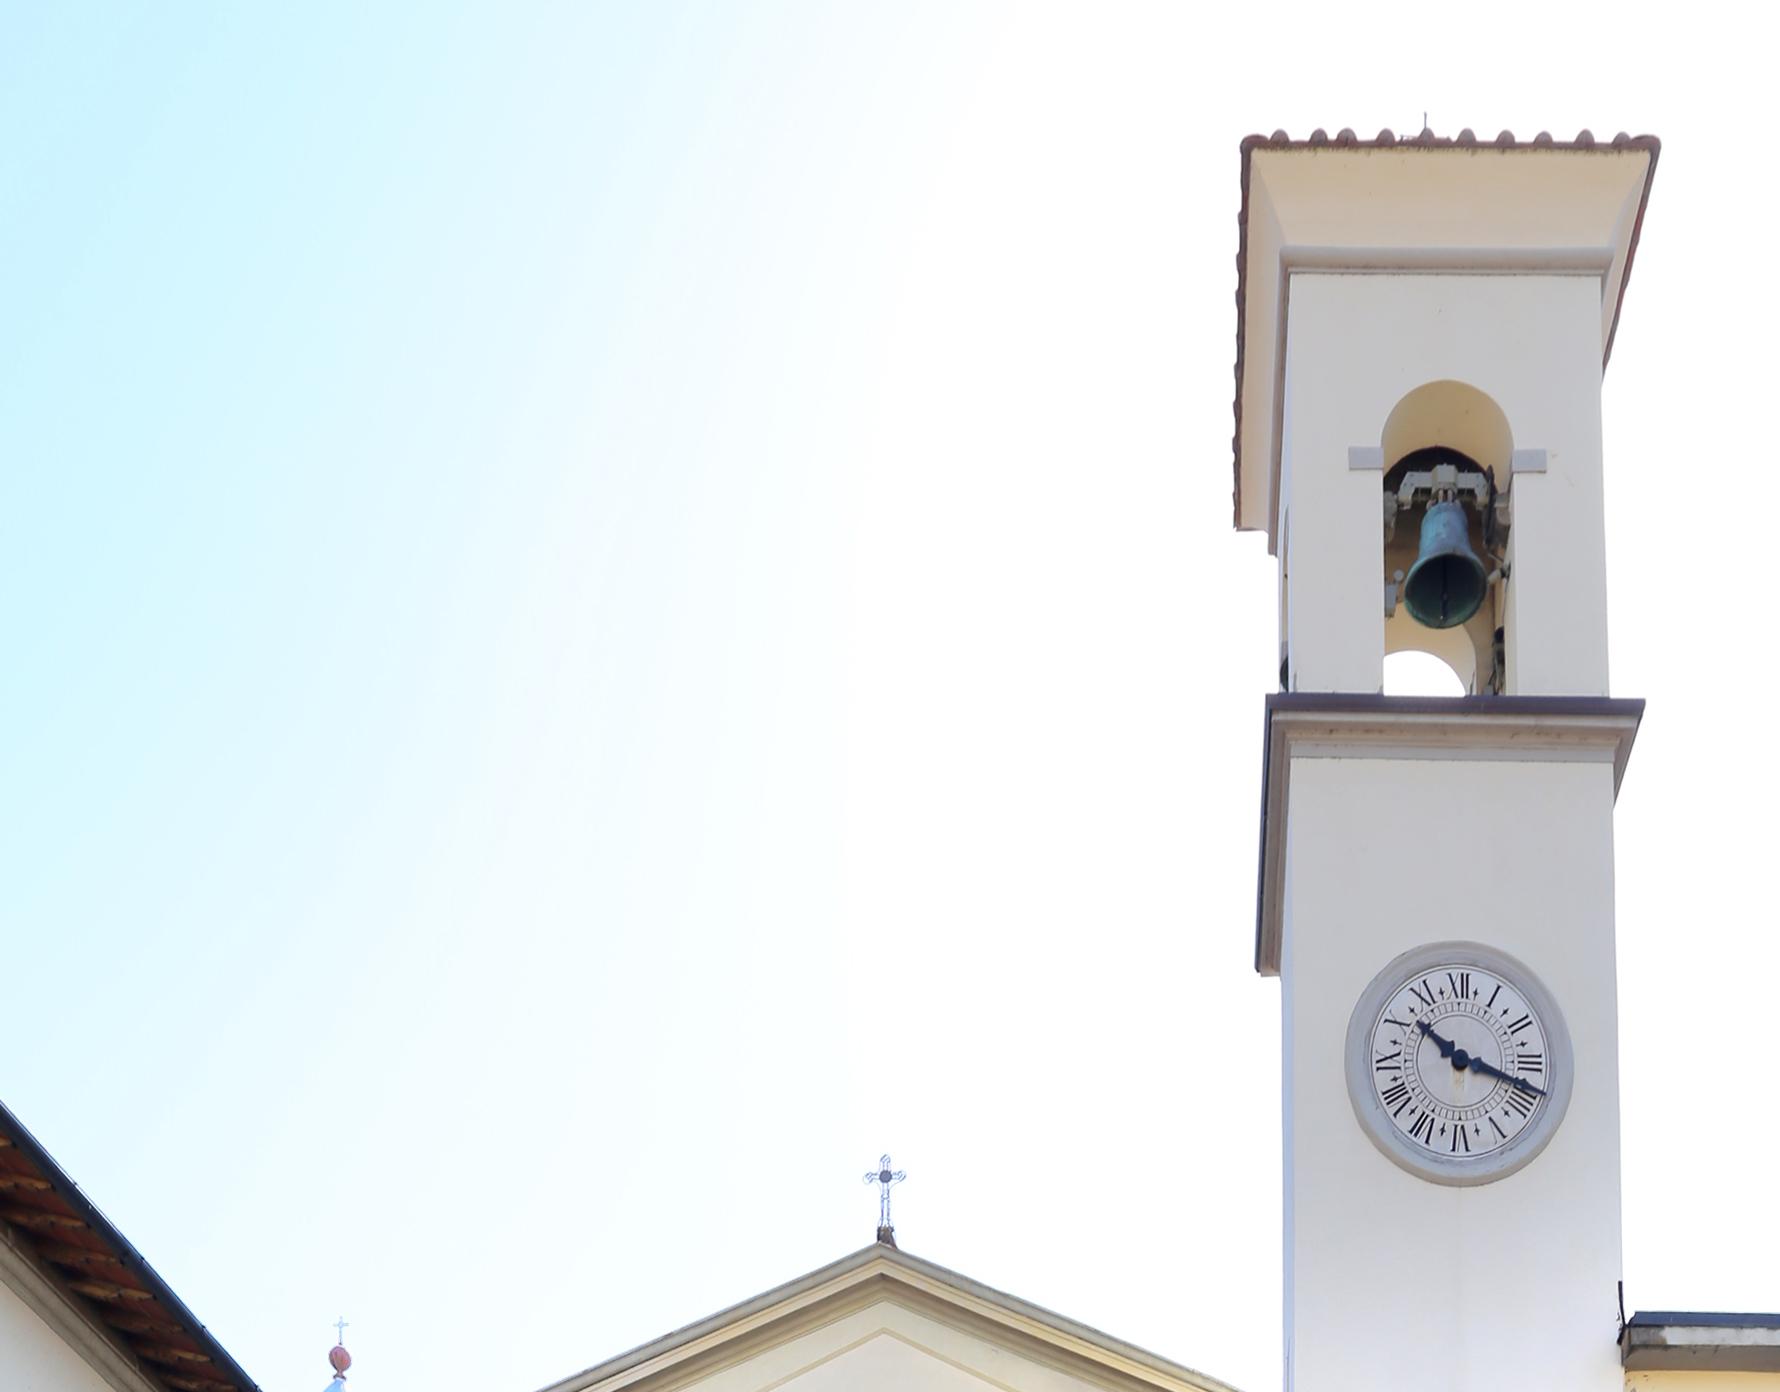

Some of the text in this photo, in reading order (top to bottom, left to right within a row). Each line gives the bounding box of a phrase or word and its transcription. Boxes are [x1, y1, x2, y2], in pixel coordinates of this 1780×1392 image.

[1409, 979, 1438, 1012] XI
[1446, 972, 1471, 1000] XII
[1486, 984, 1501, 1008] I
[1384, 1010, 1411, 1034] X
[1508, 1014, 1535, 1035] II
[1375, 1049, 1403, 1072] IX
[1517, 1053, 1542, 1074] III
[1381, 1082, 1412, 1118] VIII
[1408, 1110, 1436, 1145] VII
[1450, 1123, 1471, 1152] VI
[1488, 1117, 1508, 1145] V
